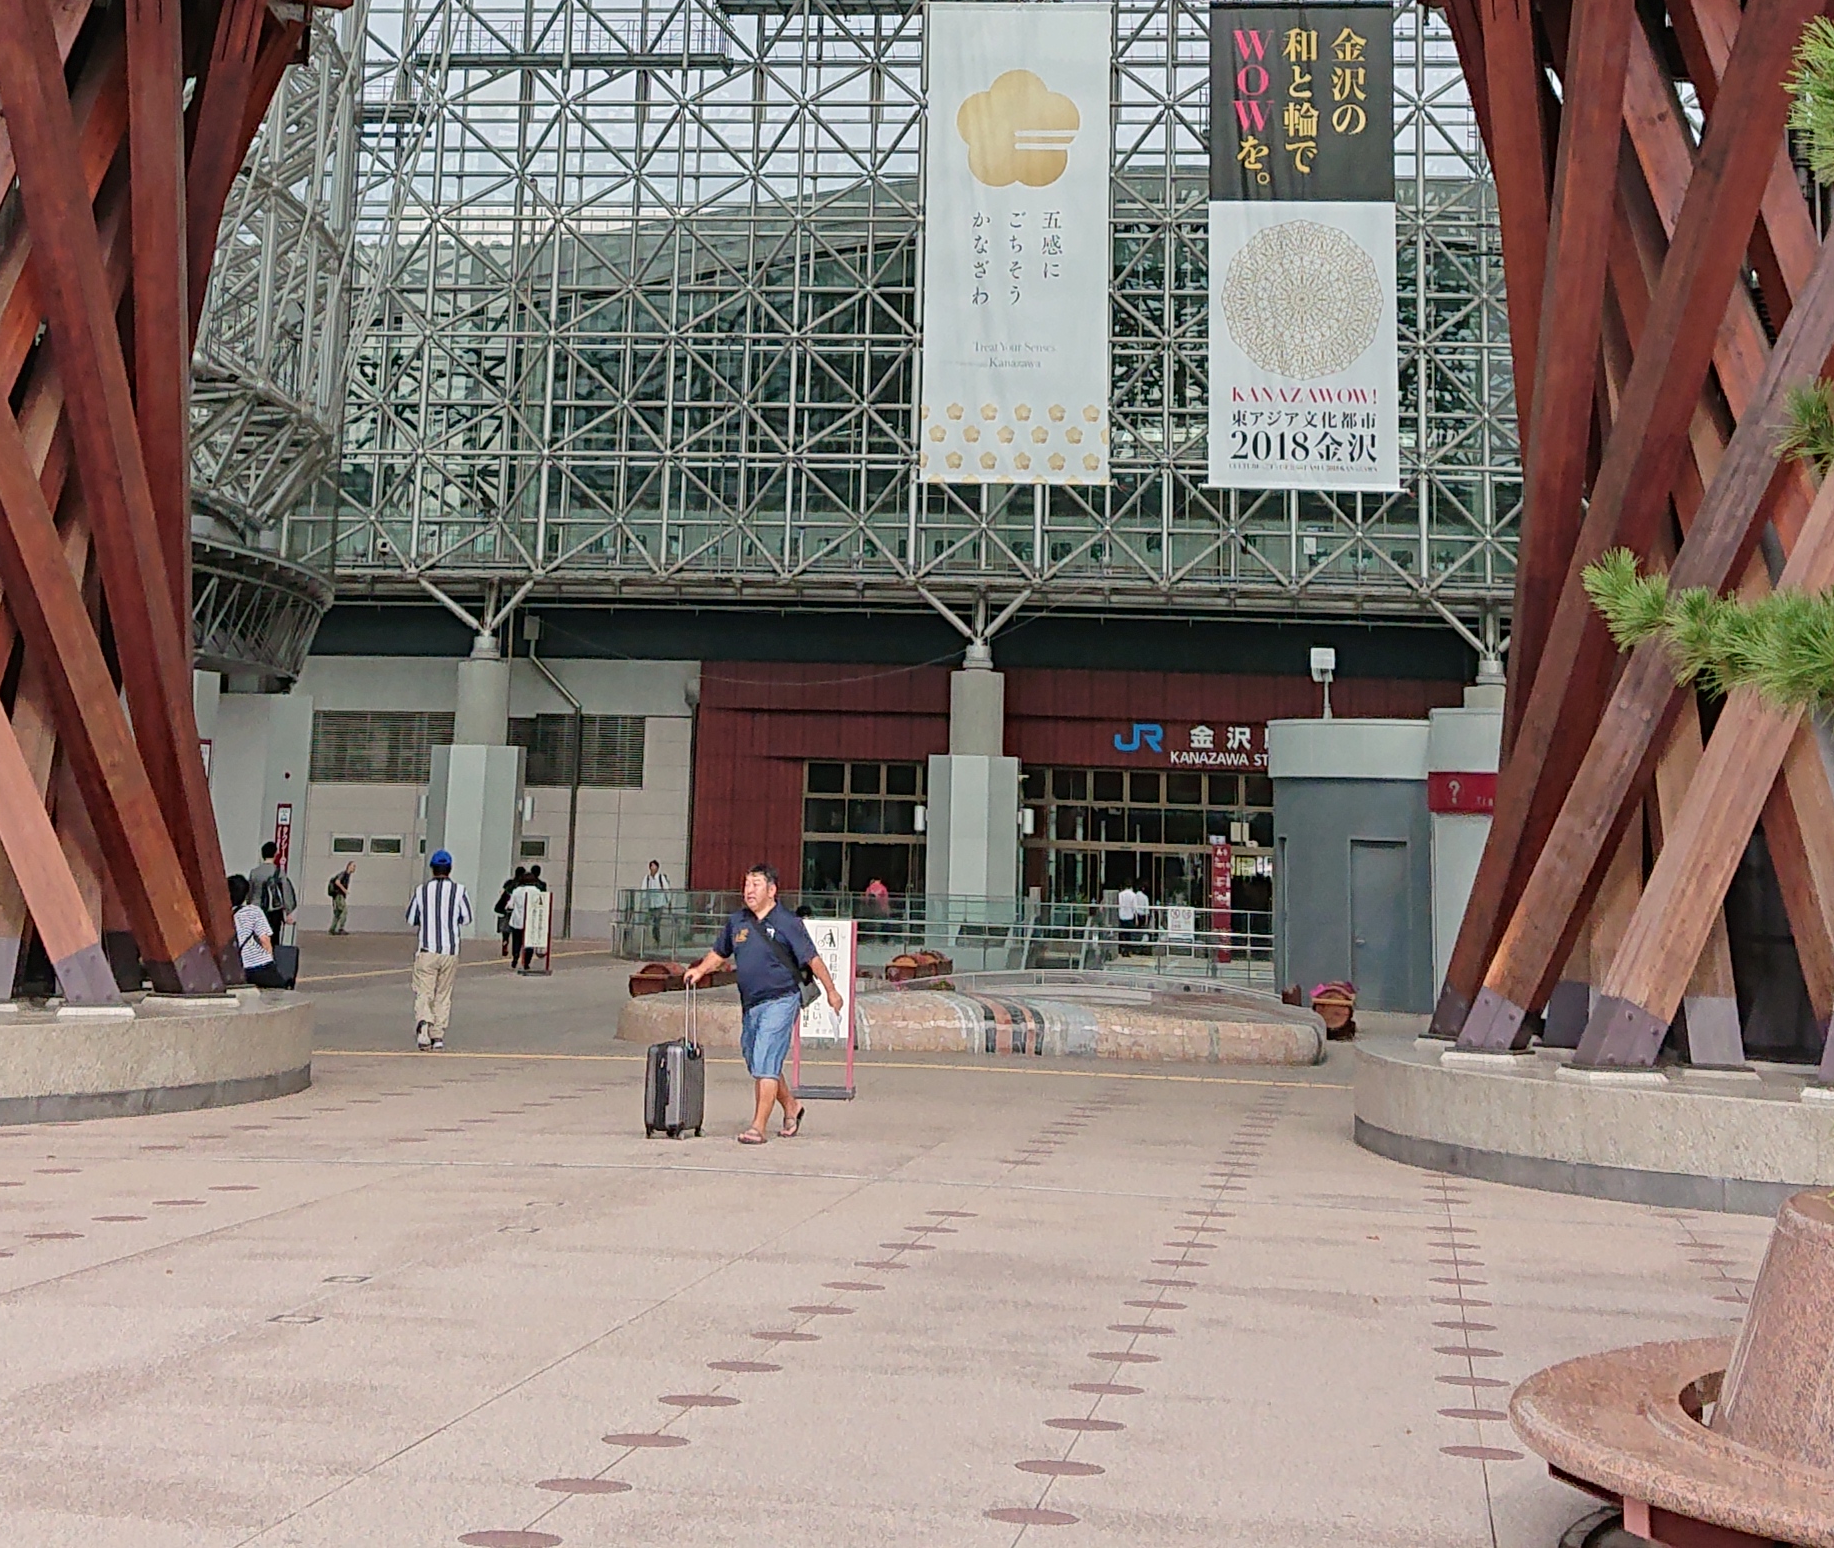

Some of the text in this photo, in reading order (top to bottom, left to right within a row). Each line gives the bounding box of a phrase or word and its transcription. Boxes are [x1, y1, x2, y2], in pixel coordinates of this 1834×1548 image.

[1329, 27, 1368, 136] 金沢の
[1281, 27, 1319, 174] 和と輪で
[971, 211, 991, 305] かなざわ
[1009, 211, 1026, 305] ごちそう
[1042, 210, 1063, 279] 五感に
[973, 341, 998, 352] Treat
[999, 341, 1022, 353] Your
[989, 356, 1042, 369] Kanazawa
[1232, 386, 1377, 404] KANAZAWOW!
[1231, 409, 1377, 429] 東アジア文化都市
[1230, 430, 1378, 463] 2018金沢
[1114, 723, 1163, 752] JR
[1189, 724, 1269, 750] 金沢
[1170, 751, 1249, 766] KANAZAWA
